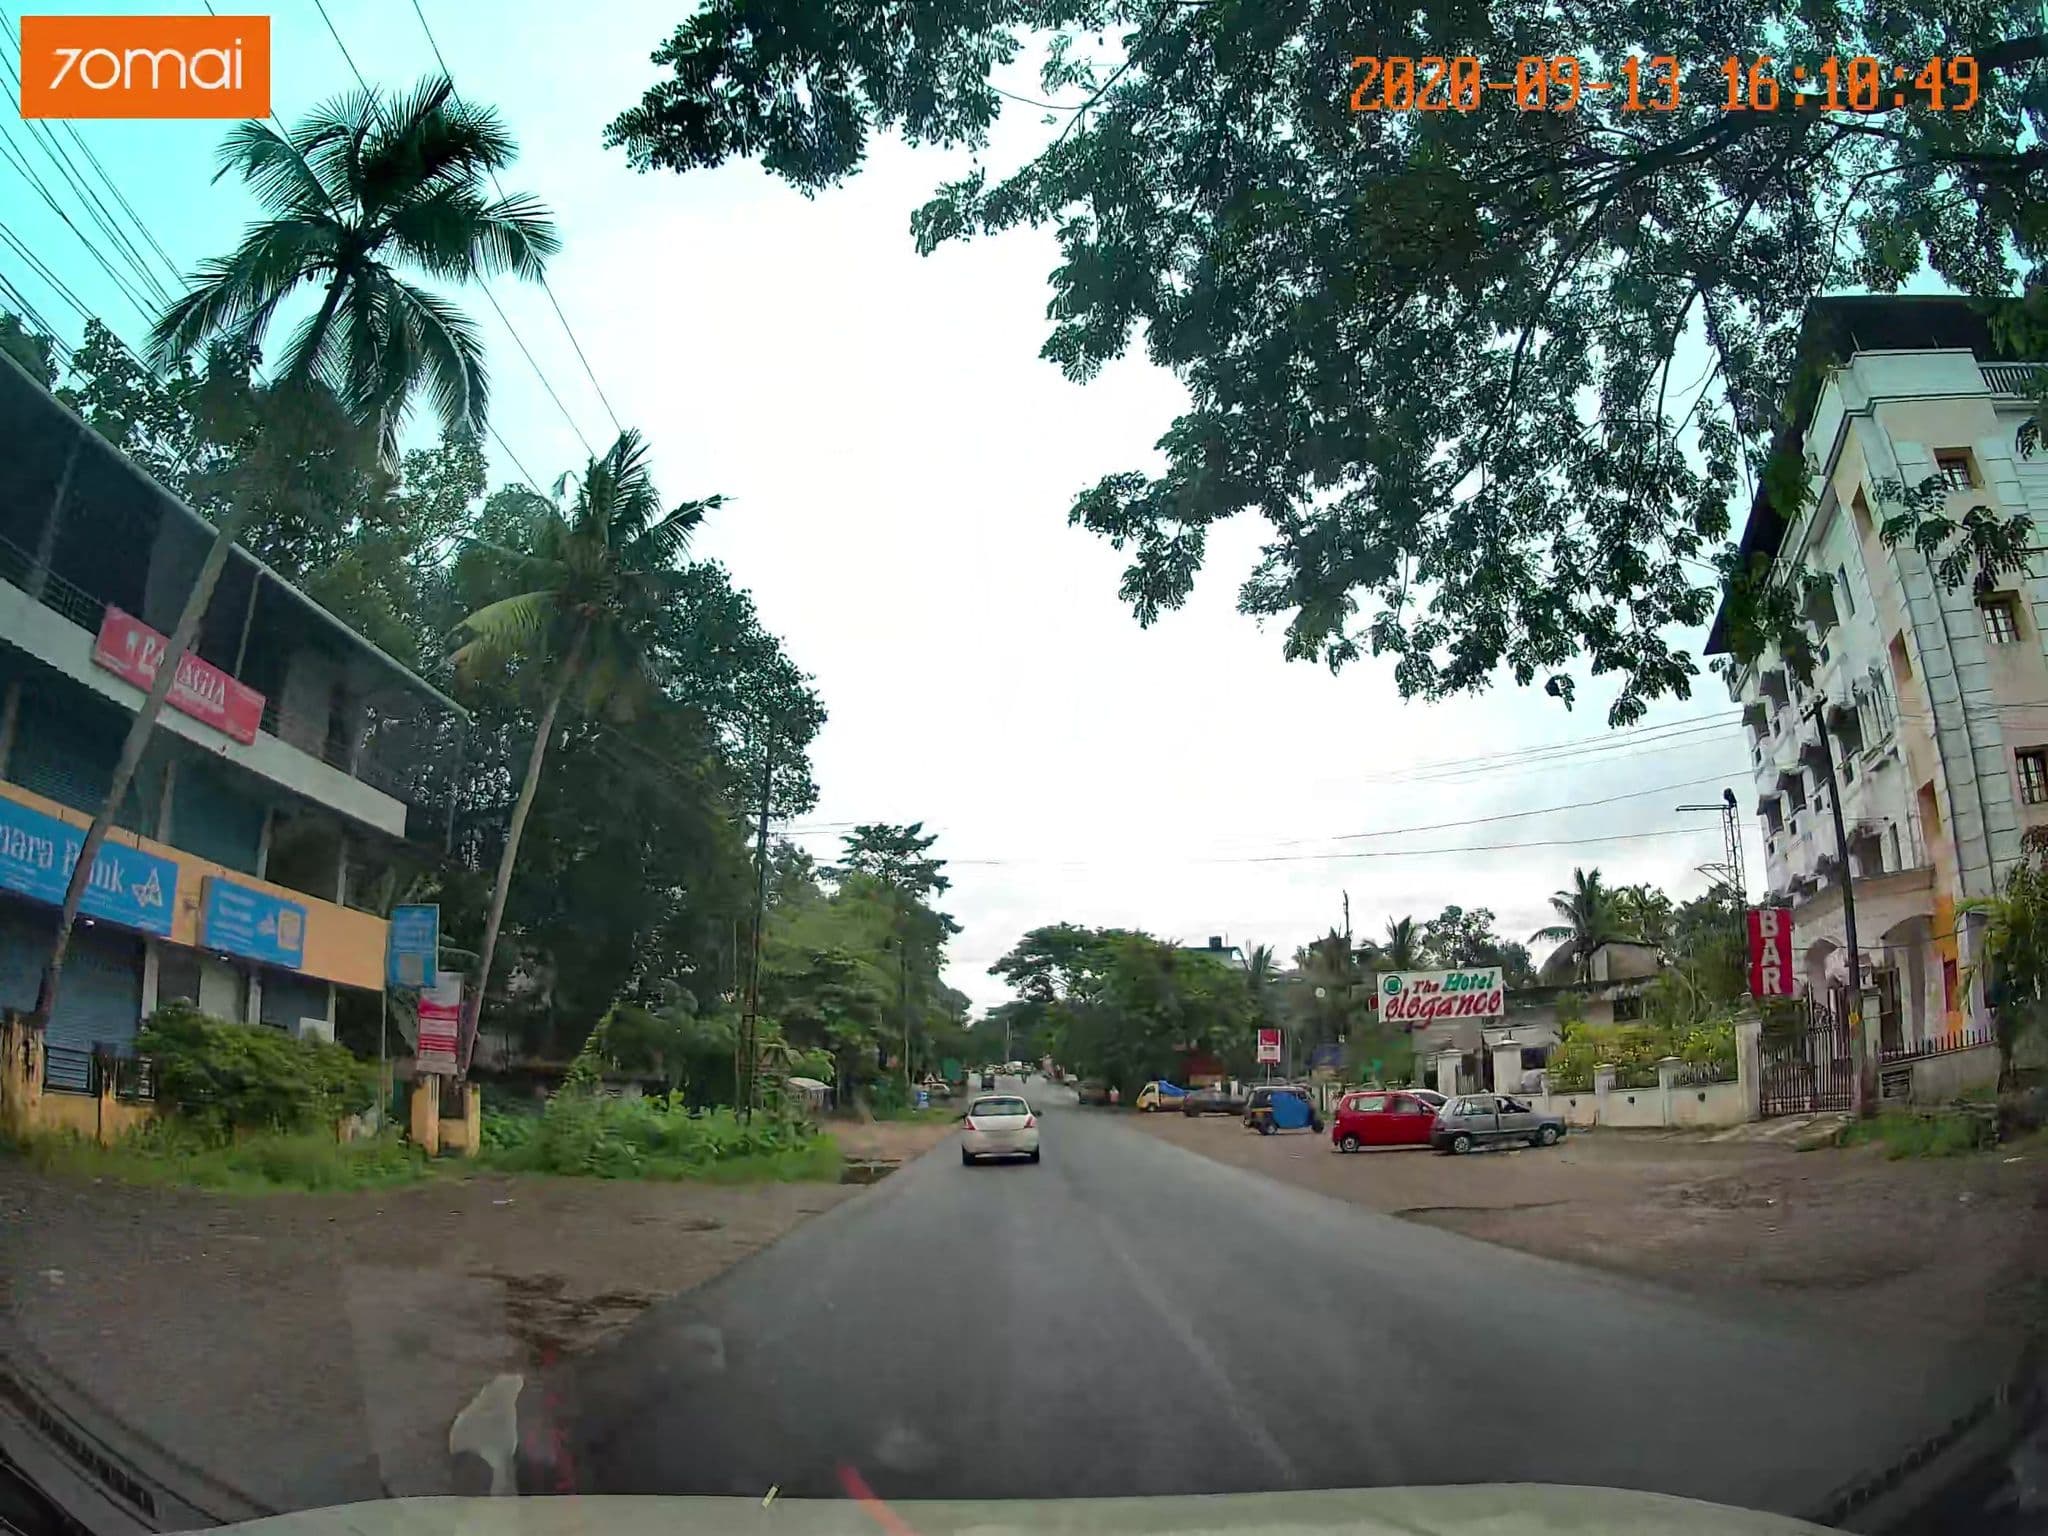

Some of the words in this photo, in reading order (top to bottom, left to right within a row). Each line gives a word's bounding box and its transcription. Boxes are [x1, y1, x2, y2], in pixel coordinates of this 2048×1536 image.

[62, 839, 125, 894] Bnk
[1759, 909, 1783, 996] BAR
[1442, 971, 1495, 992] Hotel
